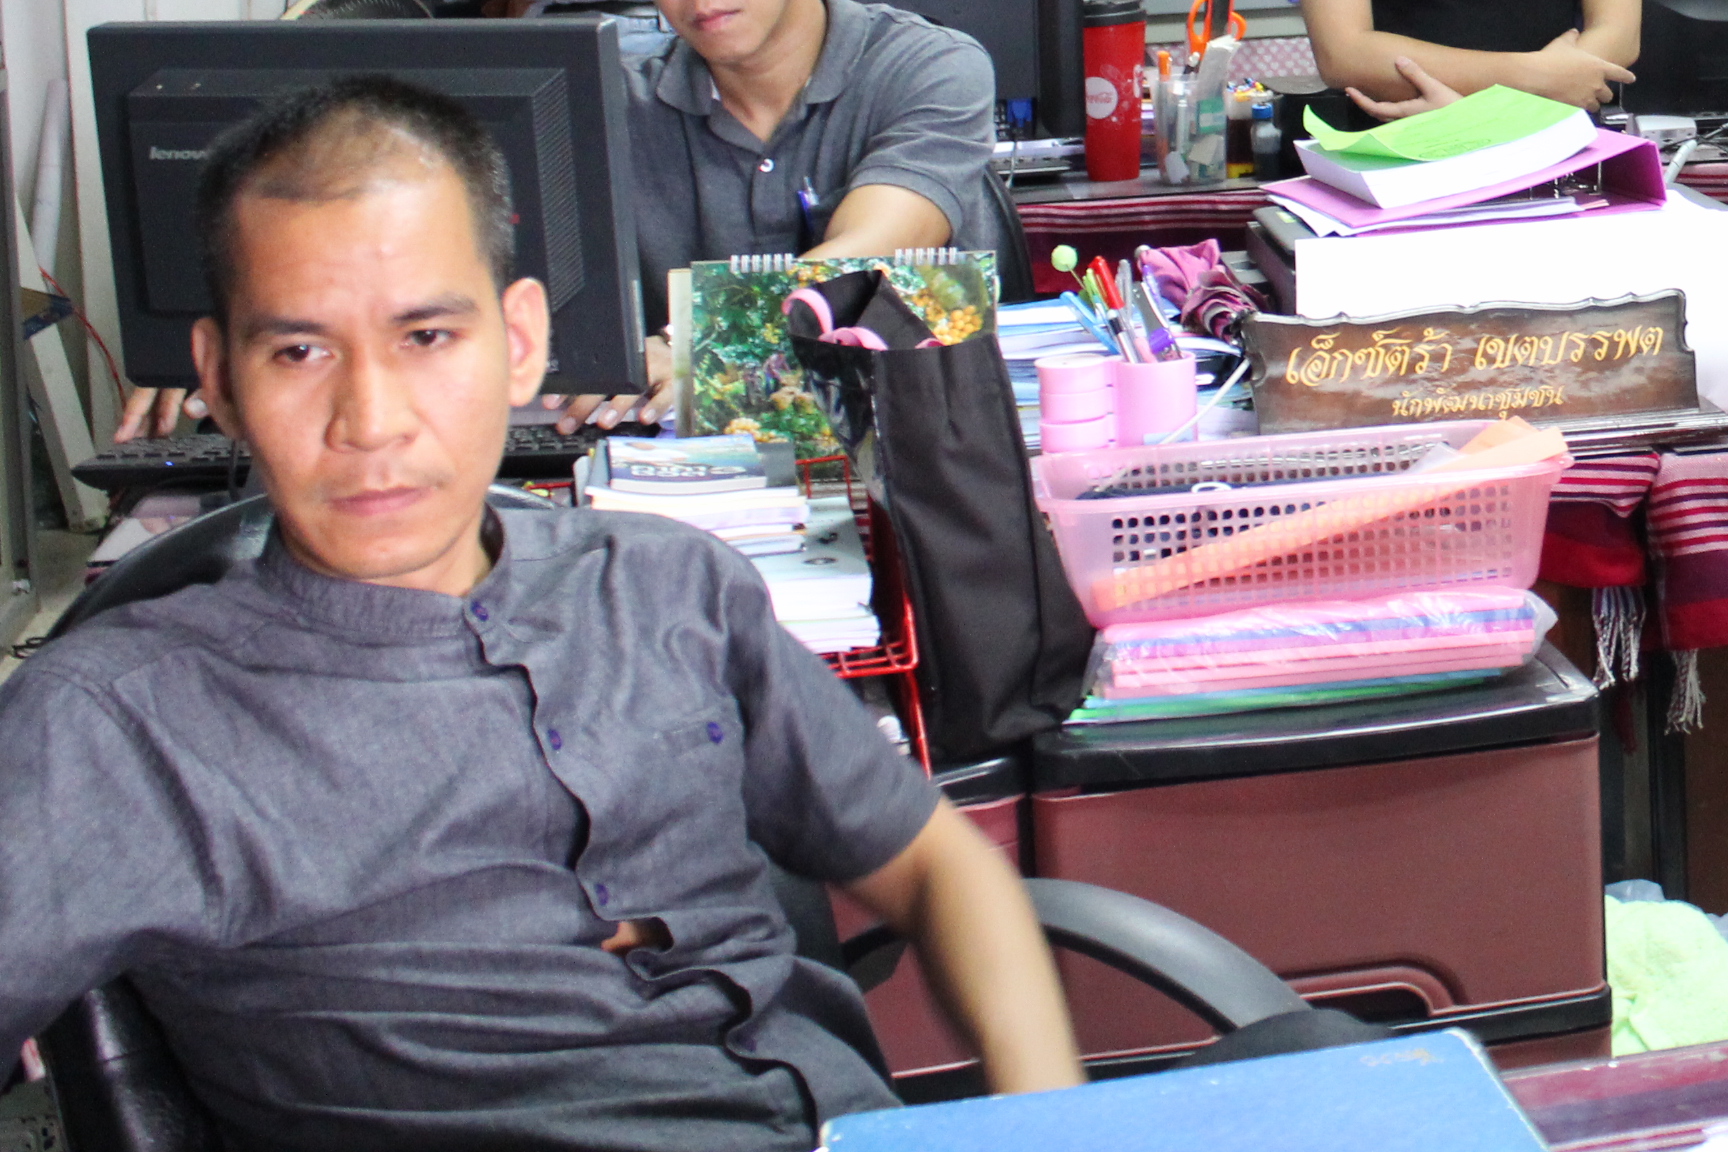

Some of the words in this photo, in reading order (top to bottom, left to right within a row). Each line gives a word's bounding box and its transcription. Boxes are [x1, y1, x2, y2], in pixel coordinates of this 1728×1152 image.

[1285, 327, 1454, 387] เอ็กซ์ตร้า
[1474, 325, 1664, 371] เขตบรรพต
[1391, 384, 1566, 417] นักพัฒนาชุมชน
